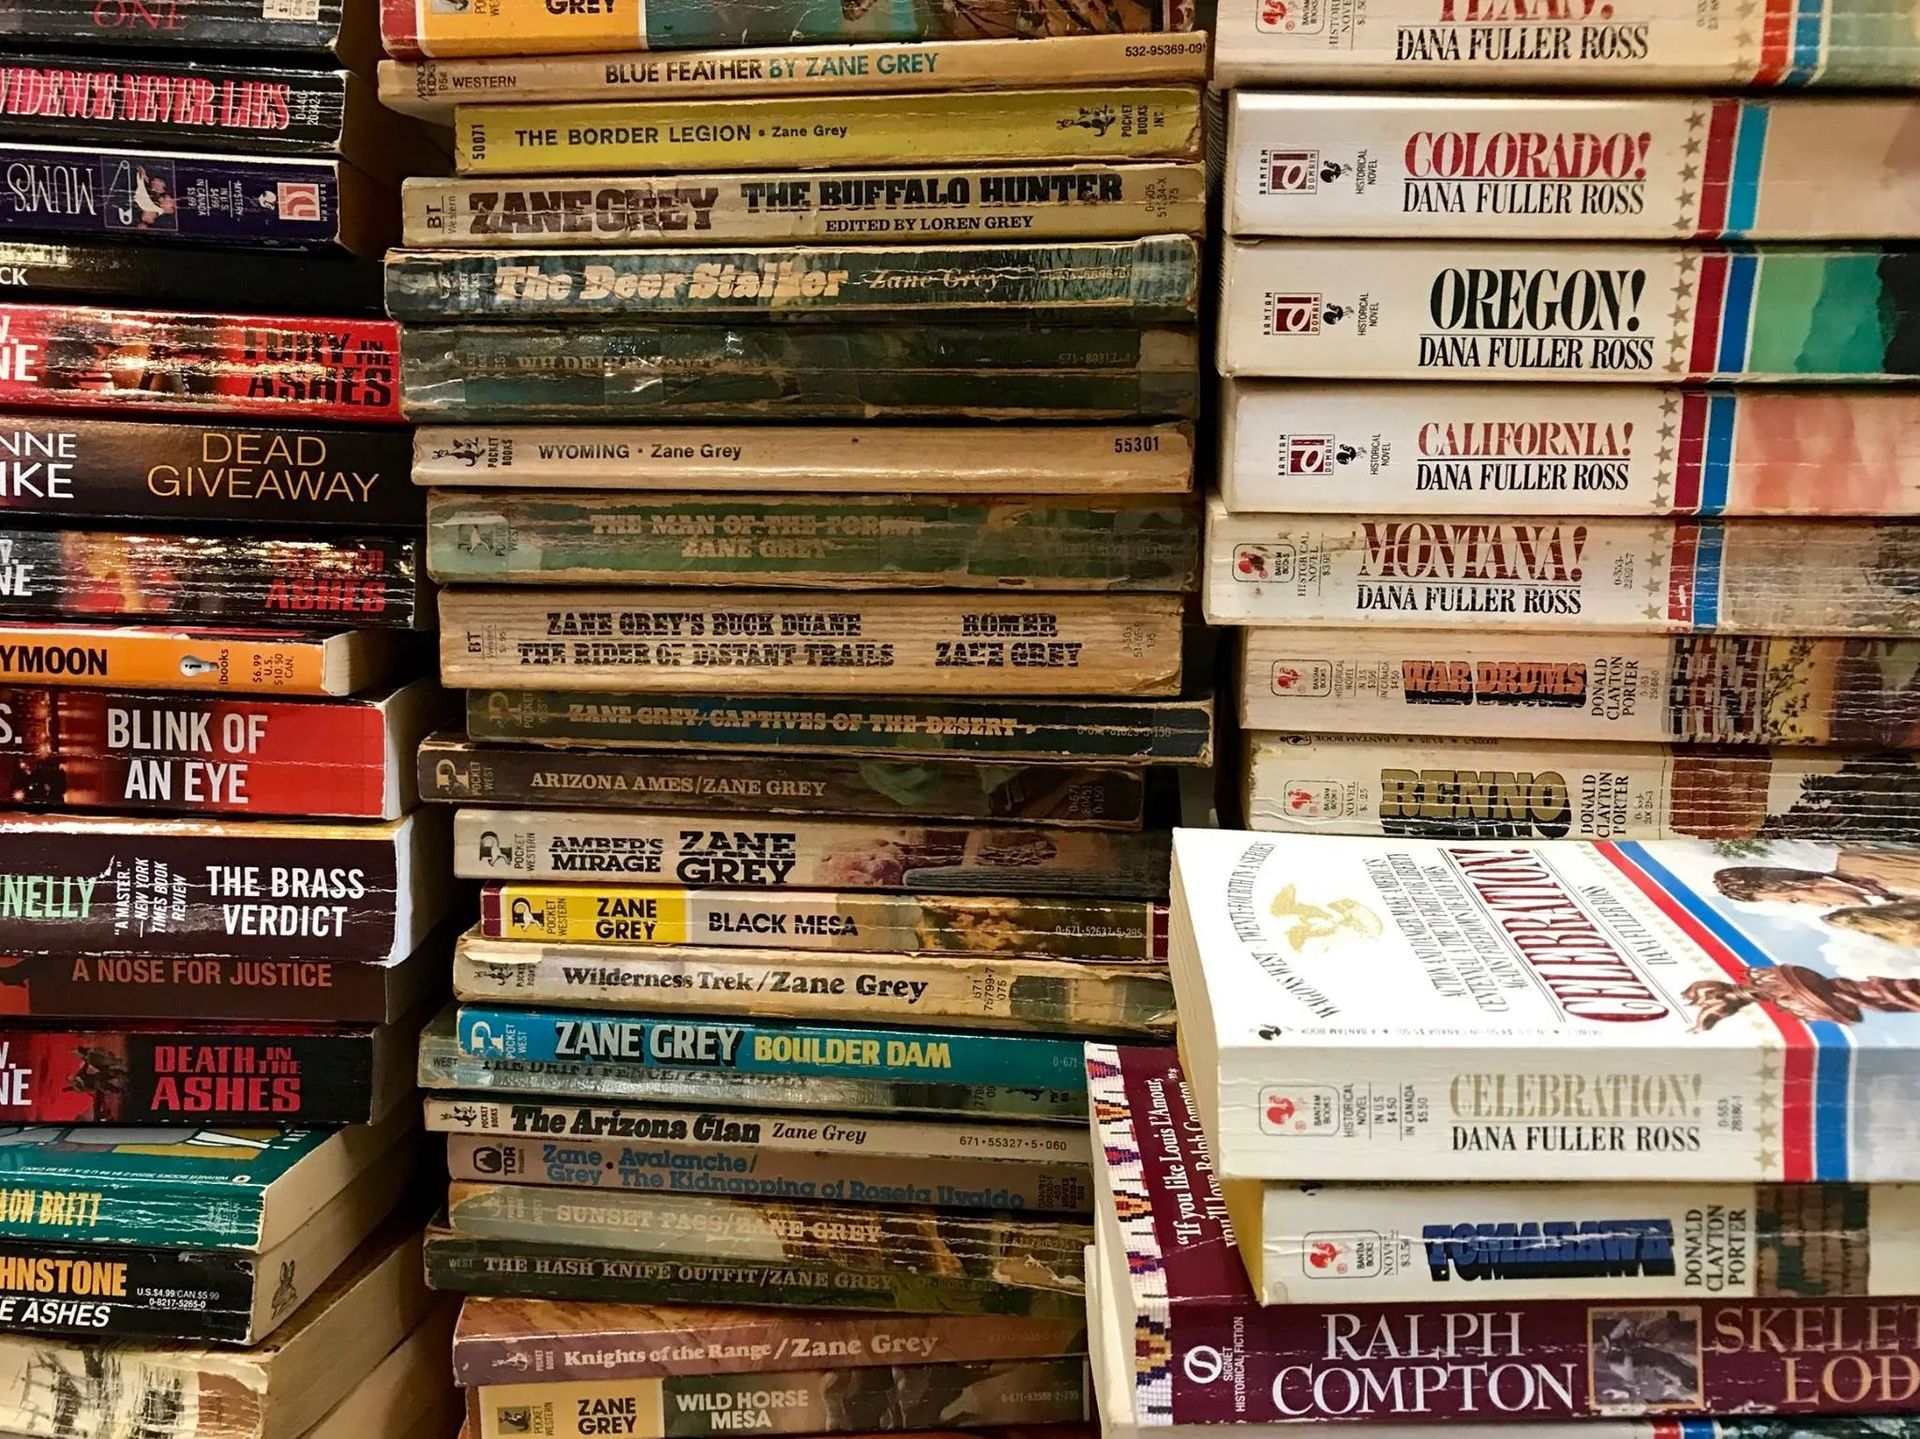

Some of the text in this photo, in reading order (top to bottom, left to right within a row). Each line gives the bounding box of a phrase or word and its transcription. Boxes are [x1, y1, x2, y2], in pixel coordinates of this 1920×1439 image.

[1395, 25, 1649, 61] DANA FULLER ROSS
[452, 52, 940, 89] WESTERN BLUE FEATHER BY ZANE GREY
[515, 123, 848, 146] THE BORDER LEGION Zane Grey
[1137, 104, 1149, 135] BOOKS
[472, 124, 486, 160] 50071
[1404, 131, 1653, 179] COLORADO!
[1259, 149, 1269, 195] BANTAM
[1355, 149, 1367, 195] HISTORICAL
[1368, 158, 1378, 186] NOVEL
[469, 187, 719, 235] ZANE GREY
[740, 174, 1123, 213] THE BUFFALO HUNTER
[1402, 182, 1645, 215] DANA FULLER ROSS
[825, 215, 1034, 233] EDITED BY LOREN GREY
[1262, 292, 1272, 336] BANTAM
[1357, 292, 1369, 336] HISTORICAL
[1369, 301, 1380, 327] NOVEL
[1430, 267, 1647, 333] OREGON!
[1418, 336, 1655, 370] DANA FULLER ROSS
[202, 432, 326, 466] DEAD
[488, 436, 498, 469] POCKET
[502, 438, 513, 466] BOOKS
[538, 443, 742, 462] WYOMING Zane Grey
[1114, 436, 1160, 454] 55301
[1278, 433, 1287, 476] BANTAM
[1370, 432, 1380, 476] HISTORICAL
[1381, 441, 1391, 467] NOVEL
[1418, 421, 1634, 457] CALIFORNIA!
[147, 465, 380, 502] GIVEAWAY
[1415, 463, 1630, 491] DANA FULLER ROSS
[1296, 530, 1309, 598] HISTORICAL
[1360, 522, 1588, 583] MONTANA!
[1355, 583, 1582, 615] DANA FULLER ROSS
[547, 612, 862, 637] ZANE GREY'S BUCK DUANE
[252, 654, 262, 683] $6.99
[264, 658, 273, 676] U.S.
[1402, 660, 1587, 708] WAR DRUMS
[1591, 657, 1607, 718] DONALD
[1606, 656, 1623, 721] CLAYTON
[1622, 660, 1639, 717] PORTER
[108, 708, 269, 755] BLINK OF
[124, 759, 249, 803] AN EYE
[1581, 773, 1597, 835] DONALD
[1596, 771, 1613, 838] CLAYTON
[1612, 774, 1629, 835] PORTER
[514, 832, 524, 870] POCKET
[526, 832, 536, 872] WESTERN
[678, 830, 796, 860] ZANE
[551, 854, 663, 873] MIRAGE
[675, 858, 797, 885] GREY
[152, 861, 168, 933] TIMES BOOK
[172, 874, 187, 922] REVIEW
[206, 865, 365, 900] THE BRASS
[223, 903, 348, 937] VERDICT
[546, 900, 556, 937] POCKET
[558, 896, 568, 937] WESTERN
[597, 898, 657, 919] ZANE
[709, 912, 859, 937] BLACK MESA
[595, 920, 656, 941] GREY
[1448, 847, 1670, 1023] CELEBRATION!
[72, 959, 333, 988] A NOSE FOR JUSTICE
[562, 966, 929, 1004] Wilderness Grey
[506, 1023, 516, 1059] POCKET
[518, 1030, 528, 1054] WEST
[554, 1019, 952, 1069] ZANE GREY BOULDER DAM
[154, 1046, 292, 1074] DEATH IN
[433, 1056, 458, 1067] WEST
[150, 1076, 301, 1112] ASHES
[1343, 1082, 1354, 1138] HISTORICAL
[1357, 1095, 1367, 1126] NOVEL
[1387, 1096, 1397, 1123] $4.50
[1405, 1084, 1415, 1119] CANADA
[1418, 1096, 1429, 1123] $5.50
[1449, 1073, 1702, 1118] CELEBRATION!
[480, 1105, 490, 1129] POCKET
[511, 1106, 868, 1145] The Arizona Clan Zane Grey
[1452, 1125, 1701, 1151] DANA FULLER ROSS
[503, 1147, 516, 1175] TOR
[38, 1191, 102, 1227] BRETT
[1685, 1208, 1704, 1288] DONALD
[1707, 1204, 1725, 1293] CLAYTON
[1728, 1208, 1747, 1287] PORTER
[21, 1302, 111, 1328] ASHES
[149, 1297, 207, 1309] 0-8217-5265-0
[563, 1334, 939, 1370] Knights of the Range Zane Grey
[1320, 1311, 1526, 1362] RALPH
[1223, 1346, 1234, 1383] SIGNET
[1234, 1315, 1245, 1413] HISTORICAL FICTION
[577, 1397, 637, 1416] ZANE
[676, 1389, 809, 1412] WILD HORSE
[1272, 1362, 1580, 1416] COMPTON
[533, 1405, 543, 1438] POCKET
[578, 1416, 637, 1435] GREY
[710, 1410, 772, 1430] MESA
